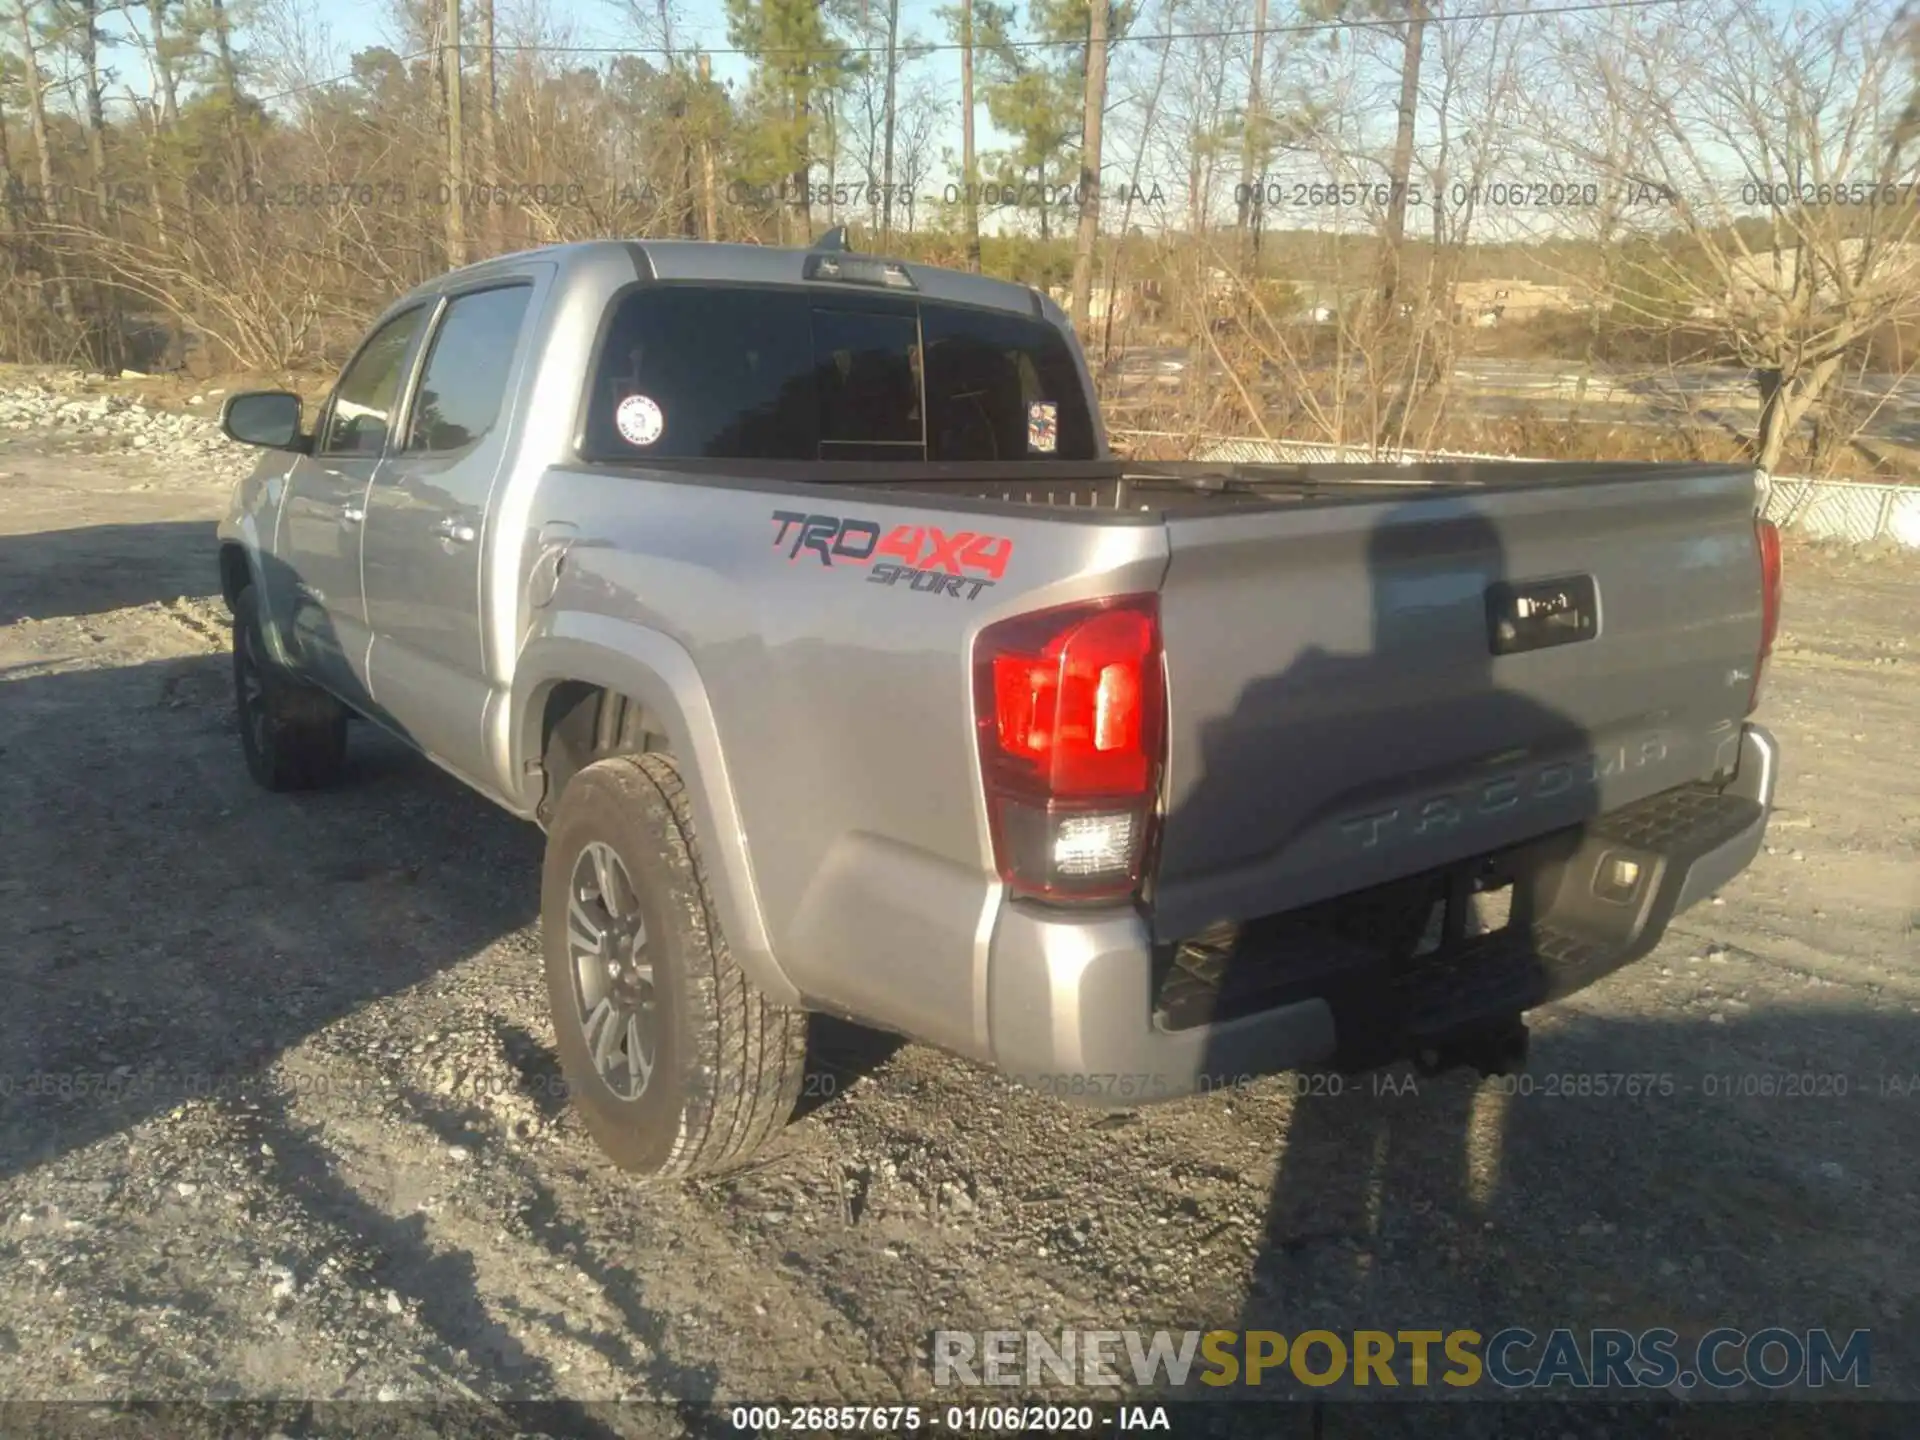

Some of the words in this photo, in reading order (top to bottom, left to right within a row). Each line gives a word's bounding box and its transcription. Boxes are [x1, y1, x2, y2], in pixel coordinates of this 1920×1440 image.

[771, 510, 881, 567] TRD
[865, 562, 996, 600] SPORT
[1339, 736, 1668, 849] TACOMA
